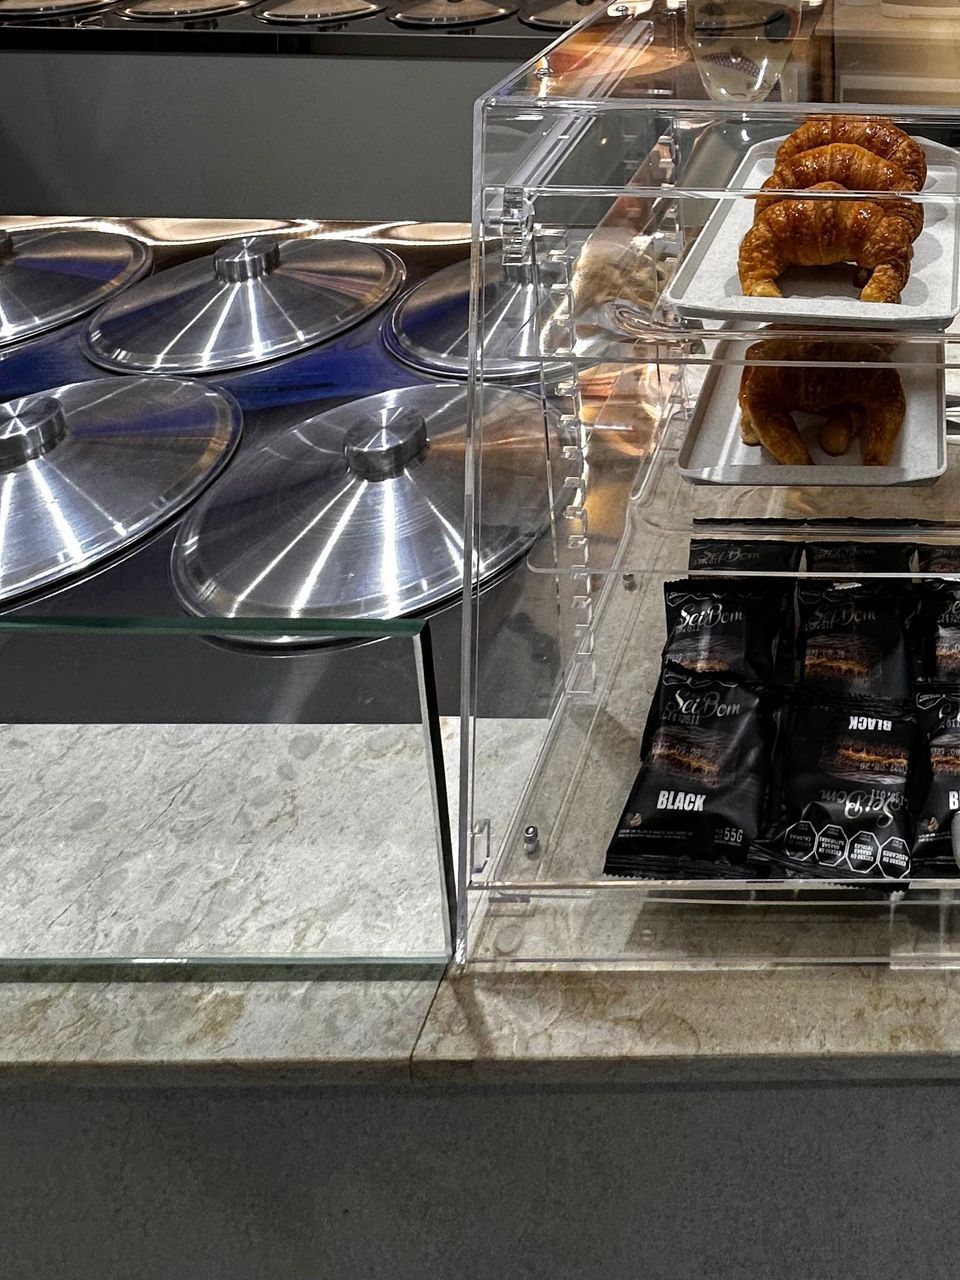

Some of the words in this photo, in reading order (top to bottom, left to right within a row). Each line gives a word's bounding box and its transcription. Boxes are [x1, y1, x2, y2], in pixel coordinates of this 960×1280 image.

[848, 715, 893, 732] BLACK
[656, 789, 707, 812] BLACK
[723, 827, 744, 843] 55G
